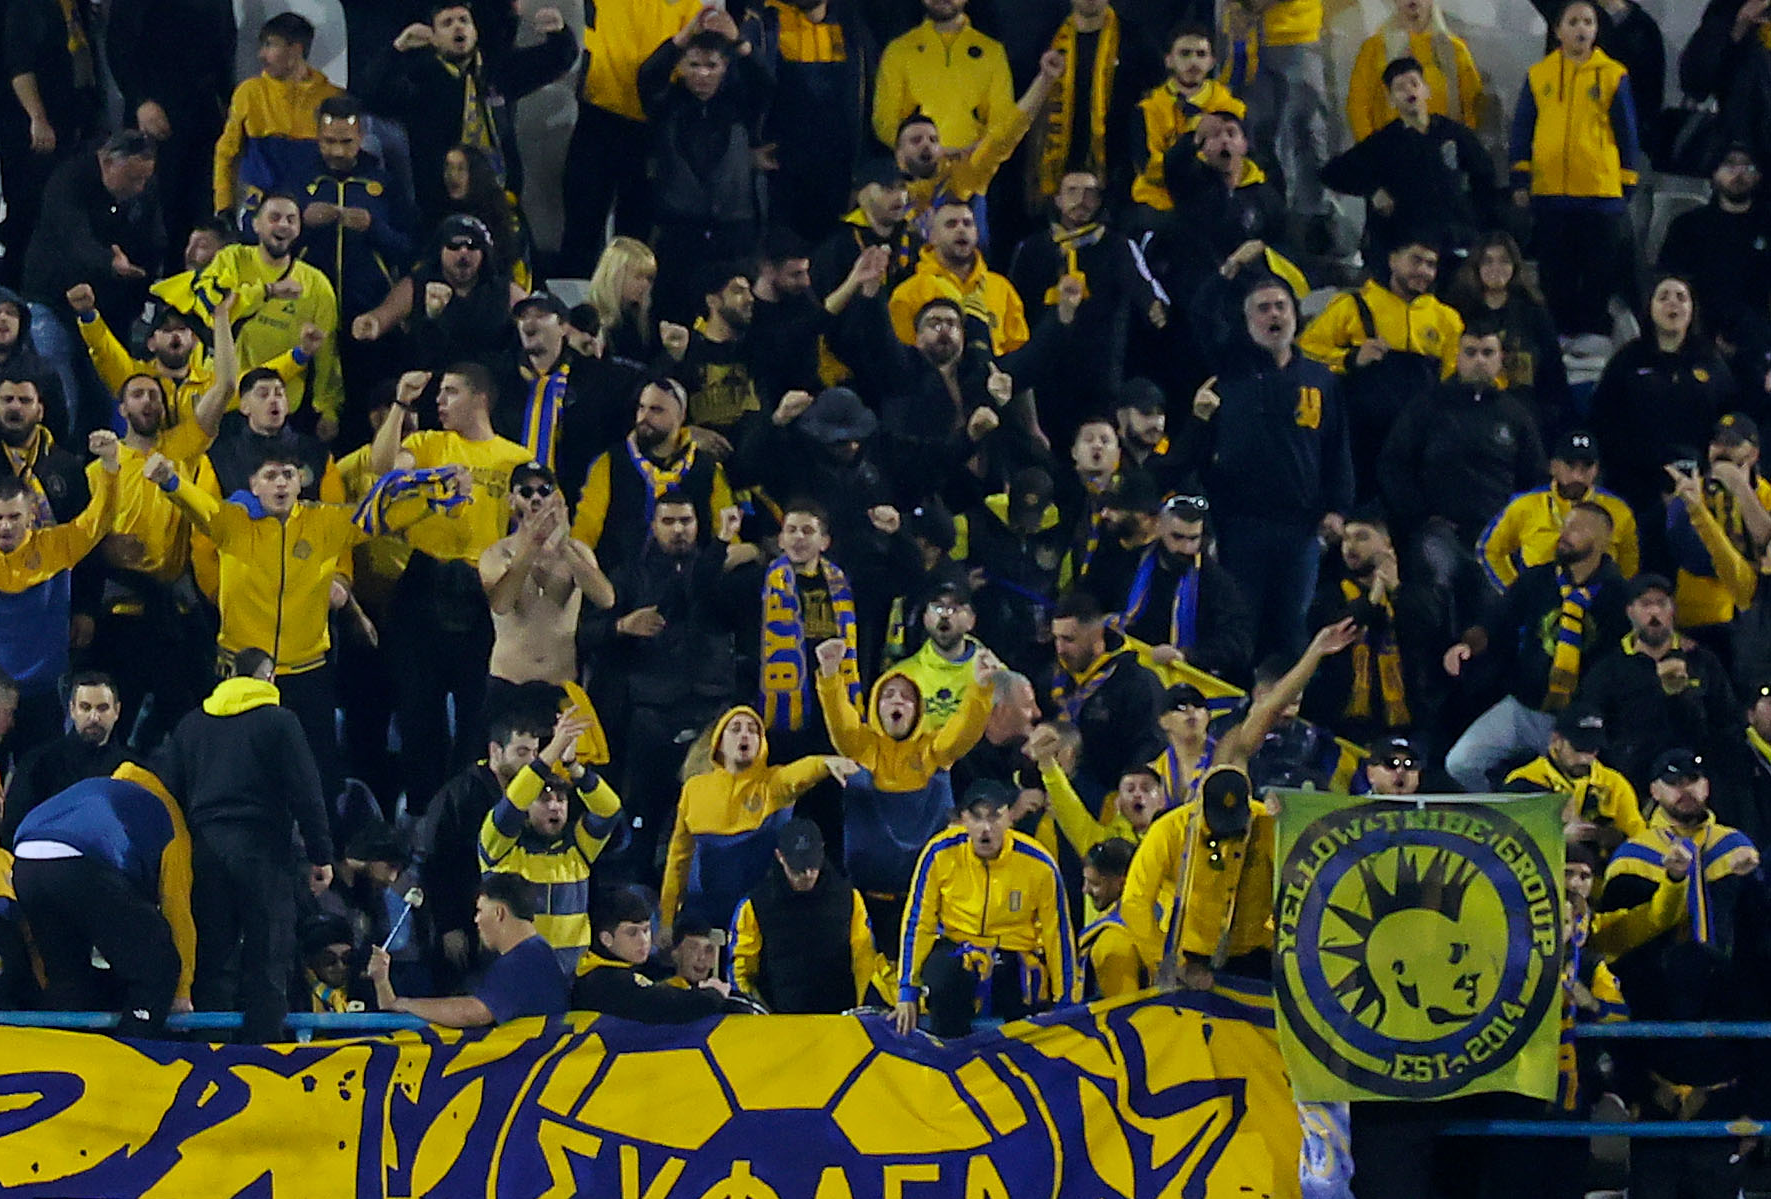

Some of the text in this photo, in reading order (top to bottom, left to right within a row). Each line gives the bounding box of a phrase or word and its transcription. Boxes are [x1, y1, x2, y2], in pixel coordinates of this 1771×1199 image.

[1278, 811, 1556, 956] YELLOW TRIBE GROUP
[1465, 1001, 1526, 1063] 2014
